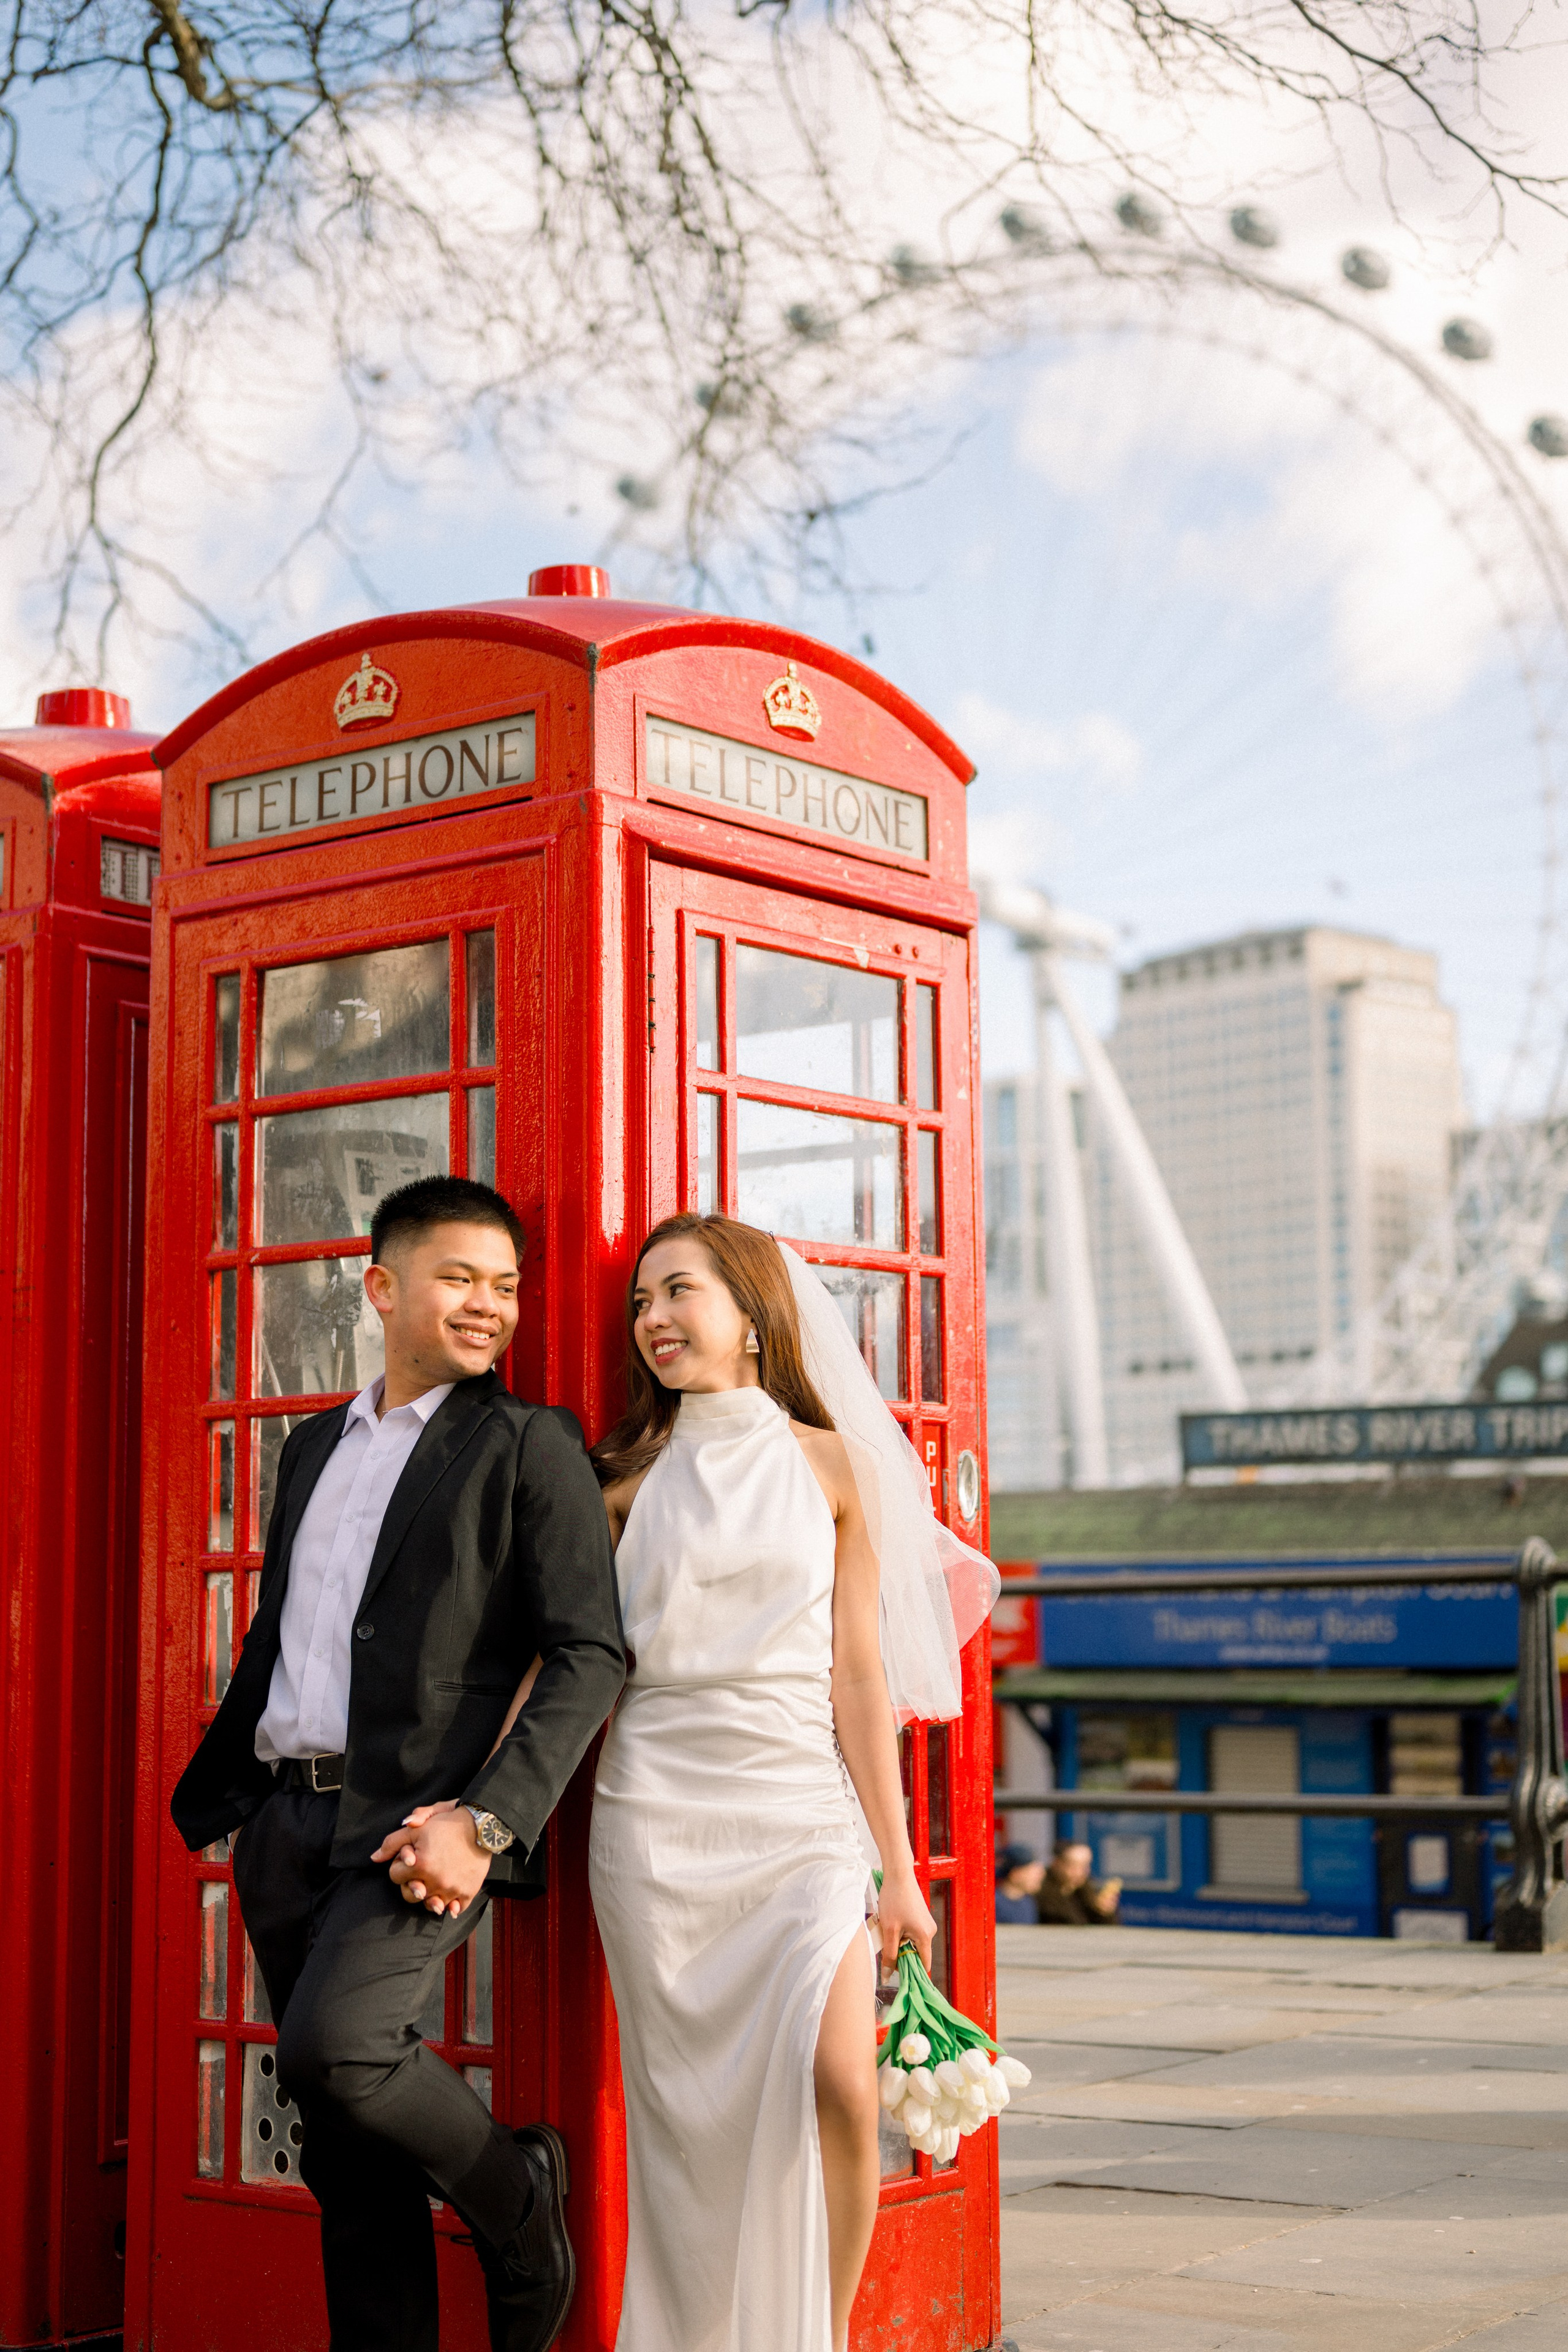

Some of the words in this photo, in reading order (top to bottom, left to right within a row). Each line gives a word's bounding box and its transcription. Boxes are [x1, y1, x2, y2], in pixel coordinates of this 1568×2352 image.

[221, 726, 526, 839] TELEPHONE
[651, 728, 913, 851] TELEPHONE
[1208, 1414, 1360, 1457] THAMES
[1368, 1410, 1476, 1454] RIVER
